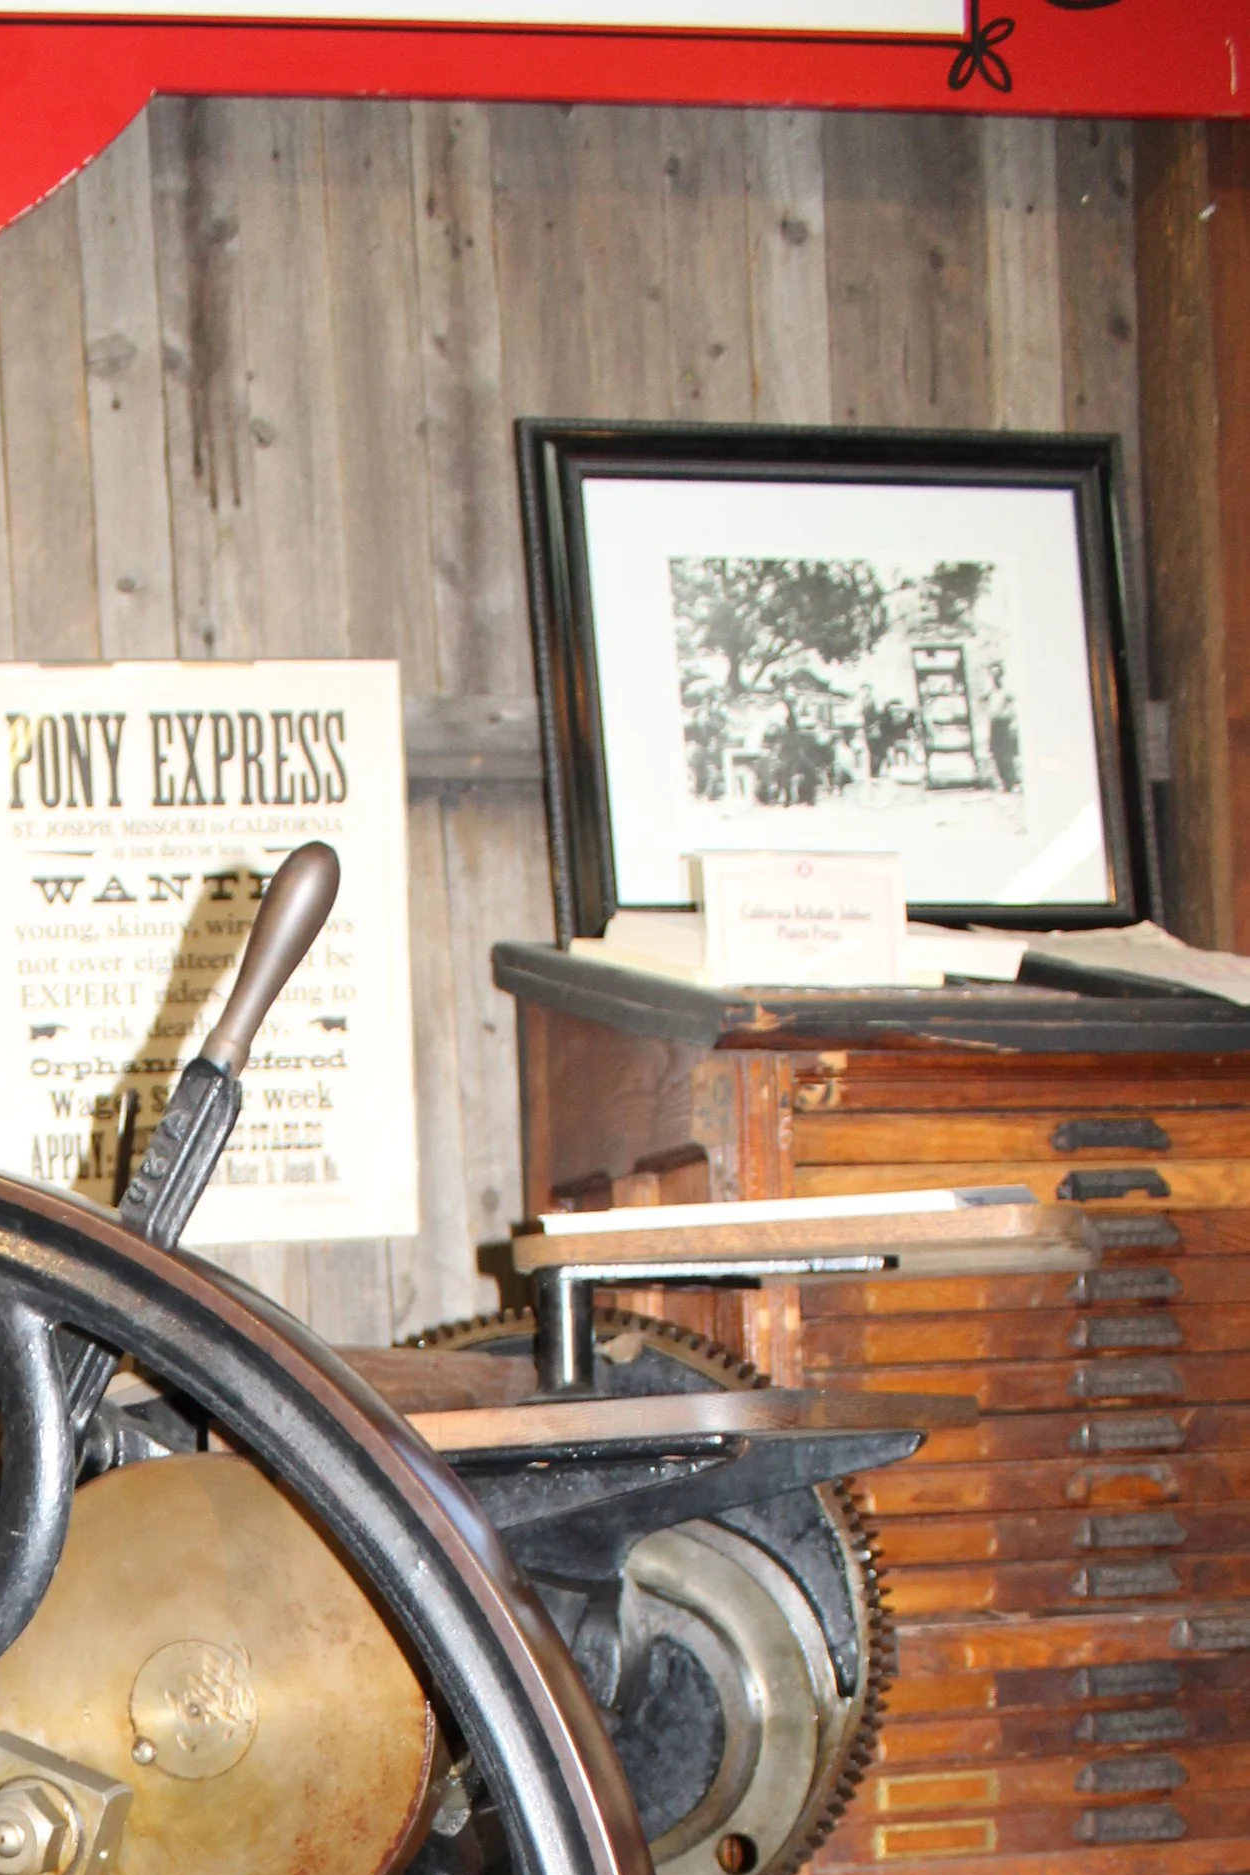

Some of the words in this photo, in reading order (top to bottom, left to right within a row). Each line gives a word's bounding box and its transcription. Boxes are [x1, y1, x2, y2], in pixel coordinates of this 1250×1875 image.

[6, 711, 127, 809] PONY
[148, 709, 348, 807] EXPRESS
[229, 815, 344, 833] CALIFORNIA
[31, 872, 273, 904] WANTE
[15, 921, 99, 945] young,
[107, 913, 199, 940] skinny,
[206, 913, 256, 935] wir
[17, 956, 59, 975] not
[68, 955, 124, 973] over
[325, 943, 354, 966] be
[20, 981, 143, 1009] EXPERT
[332, 984, 358, 1001] to
[90, 1016, 134, 1040] risk
[30, 1057, 187, 1080] Orphans
[247, 1049, 348, 1071] efered
[263, 1080, 334, 1111] week
